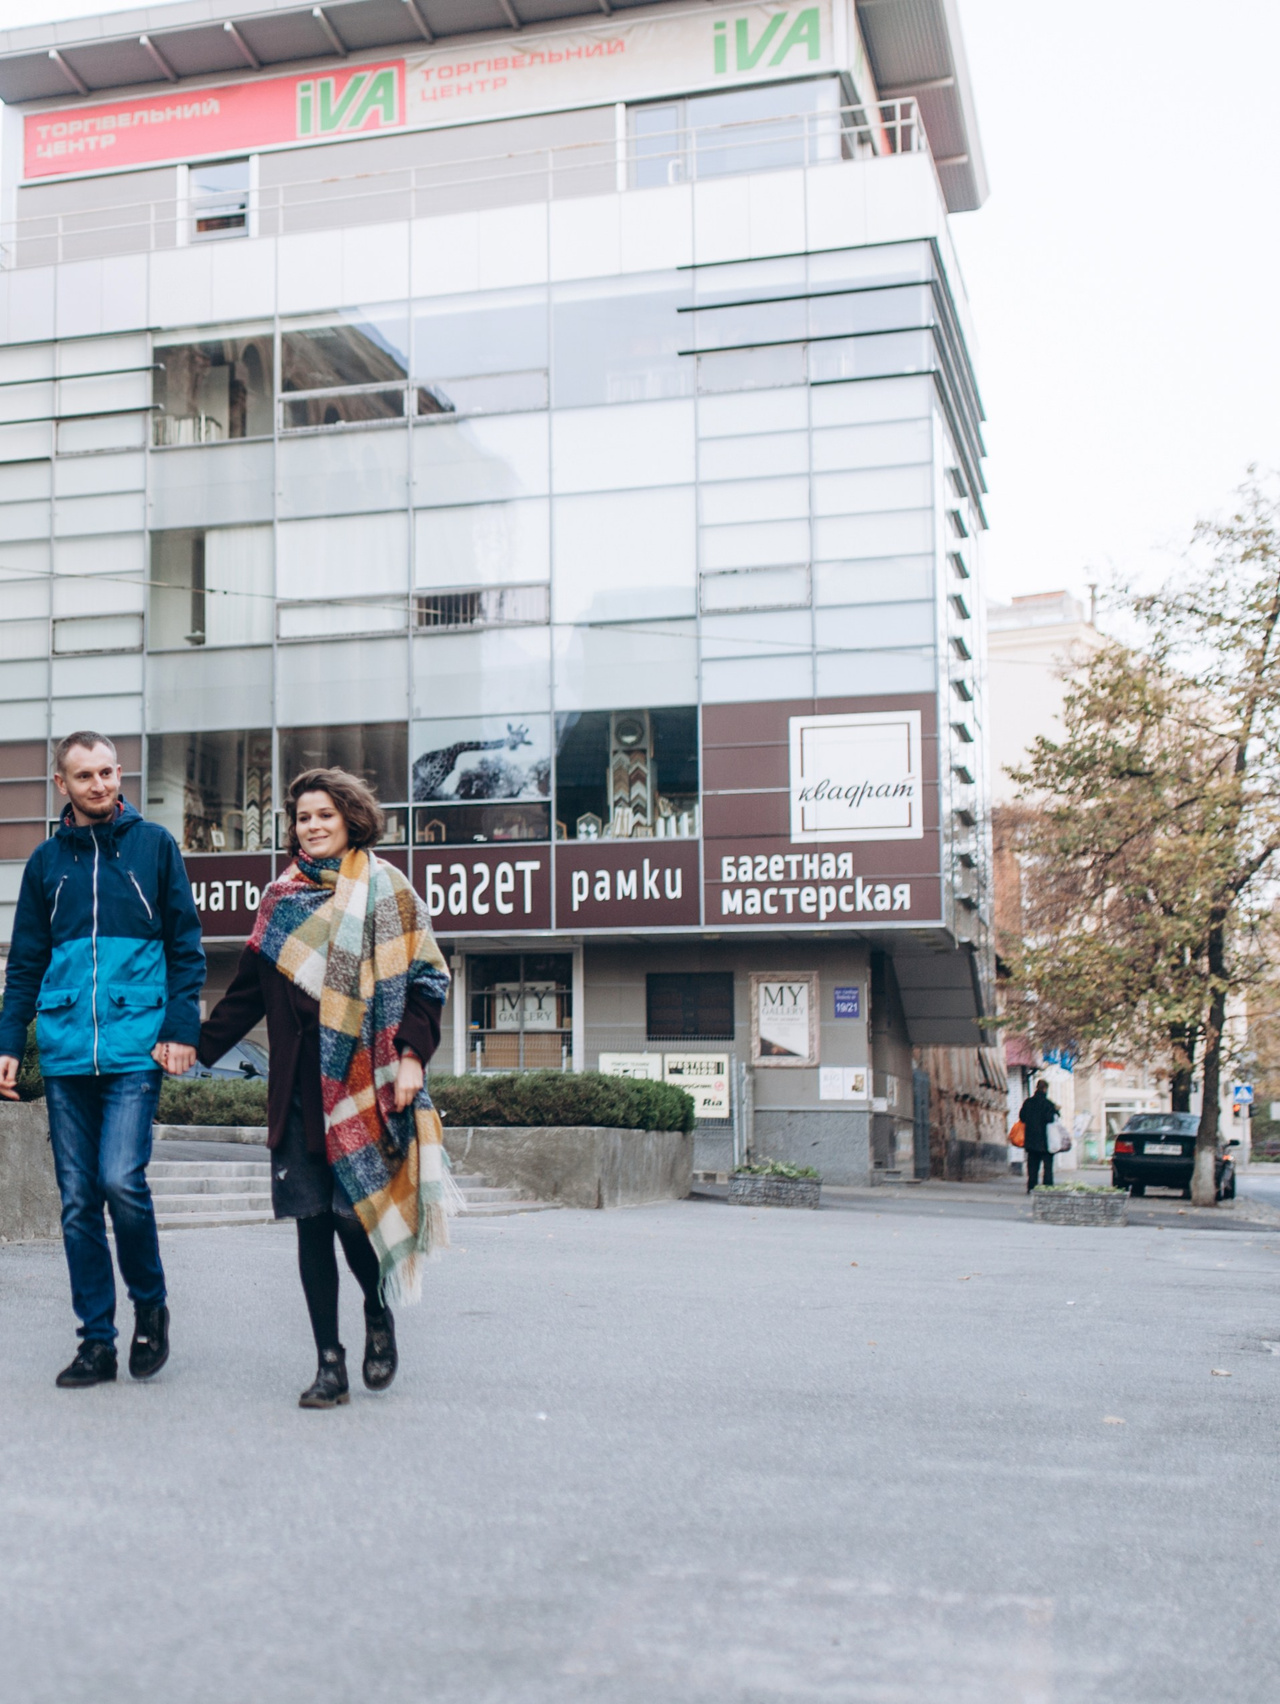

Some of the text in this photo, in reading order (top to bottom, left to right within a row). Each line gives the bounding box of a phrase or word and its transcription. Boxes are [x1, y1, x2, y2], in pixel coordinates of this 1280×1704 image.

[421, 76, 508, 103] ЦЕНТР
[36, 133, 117, 159] ЦЕНТР
[571, 858, 683, 911] рамки
[721, 877, 911, 920] мастерская
[500, 986, 552, 1012] MY
[763, 985, 804, 1006] MY
